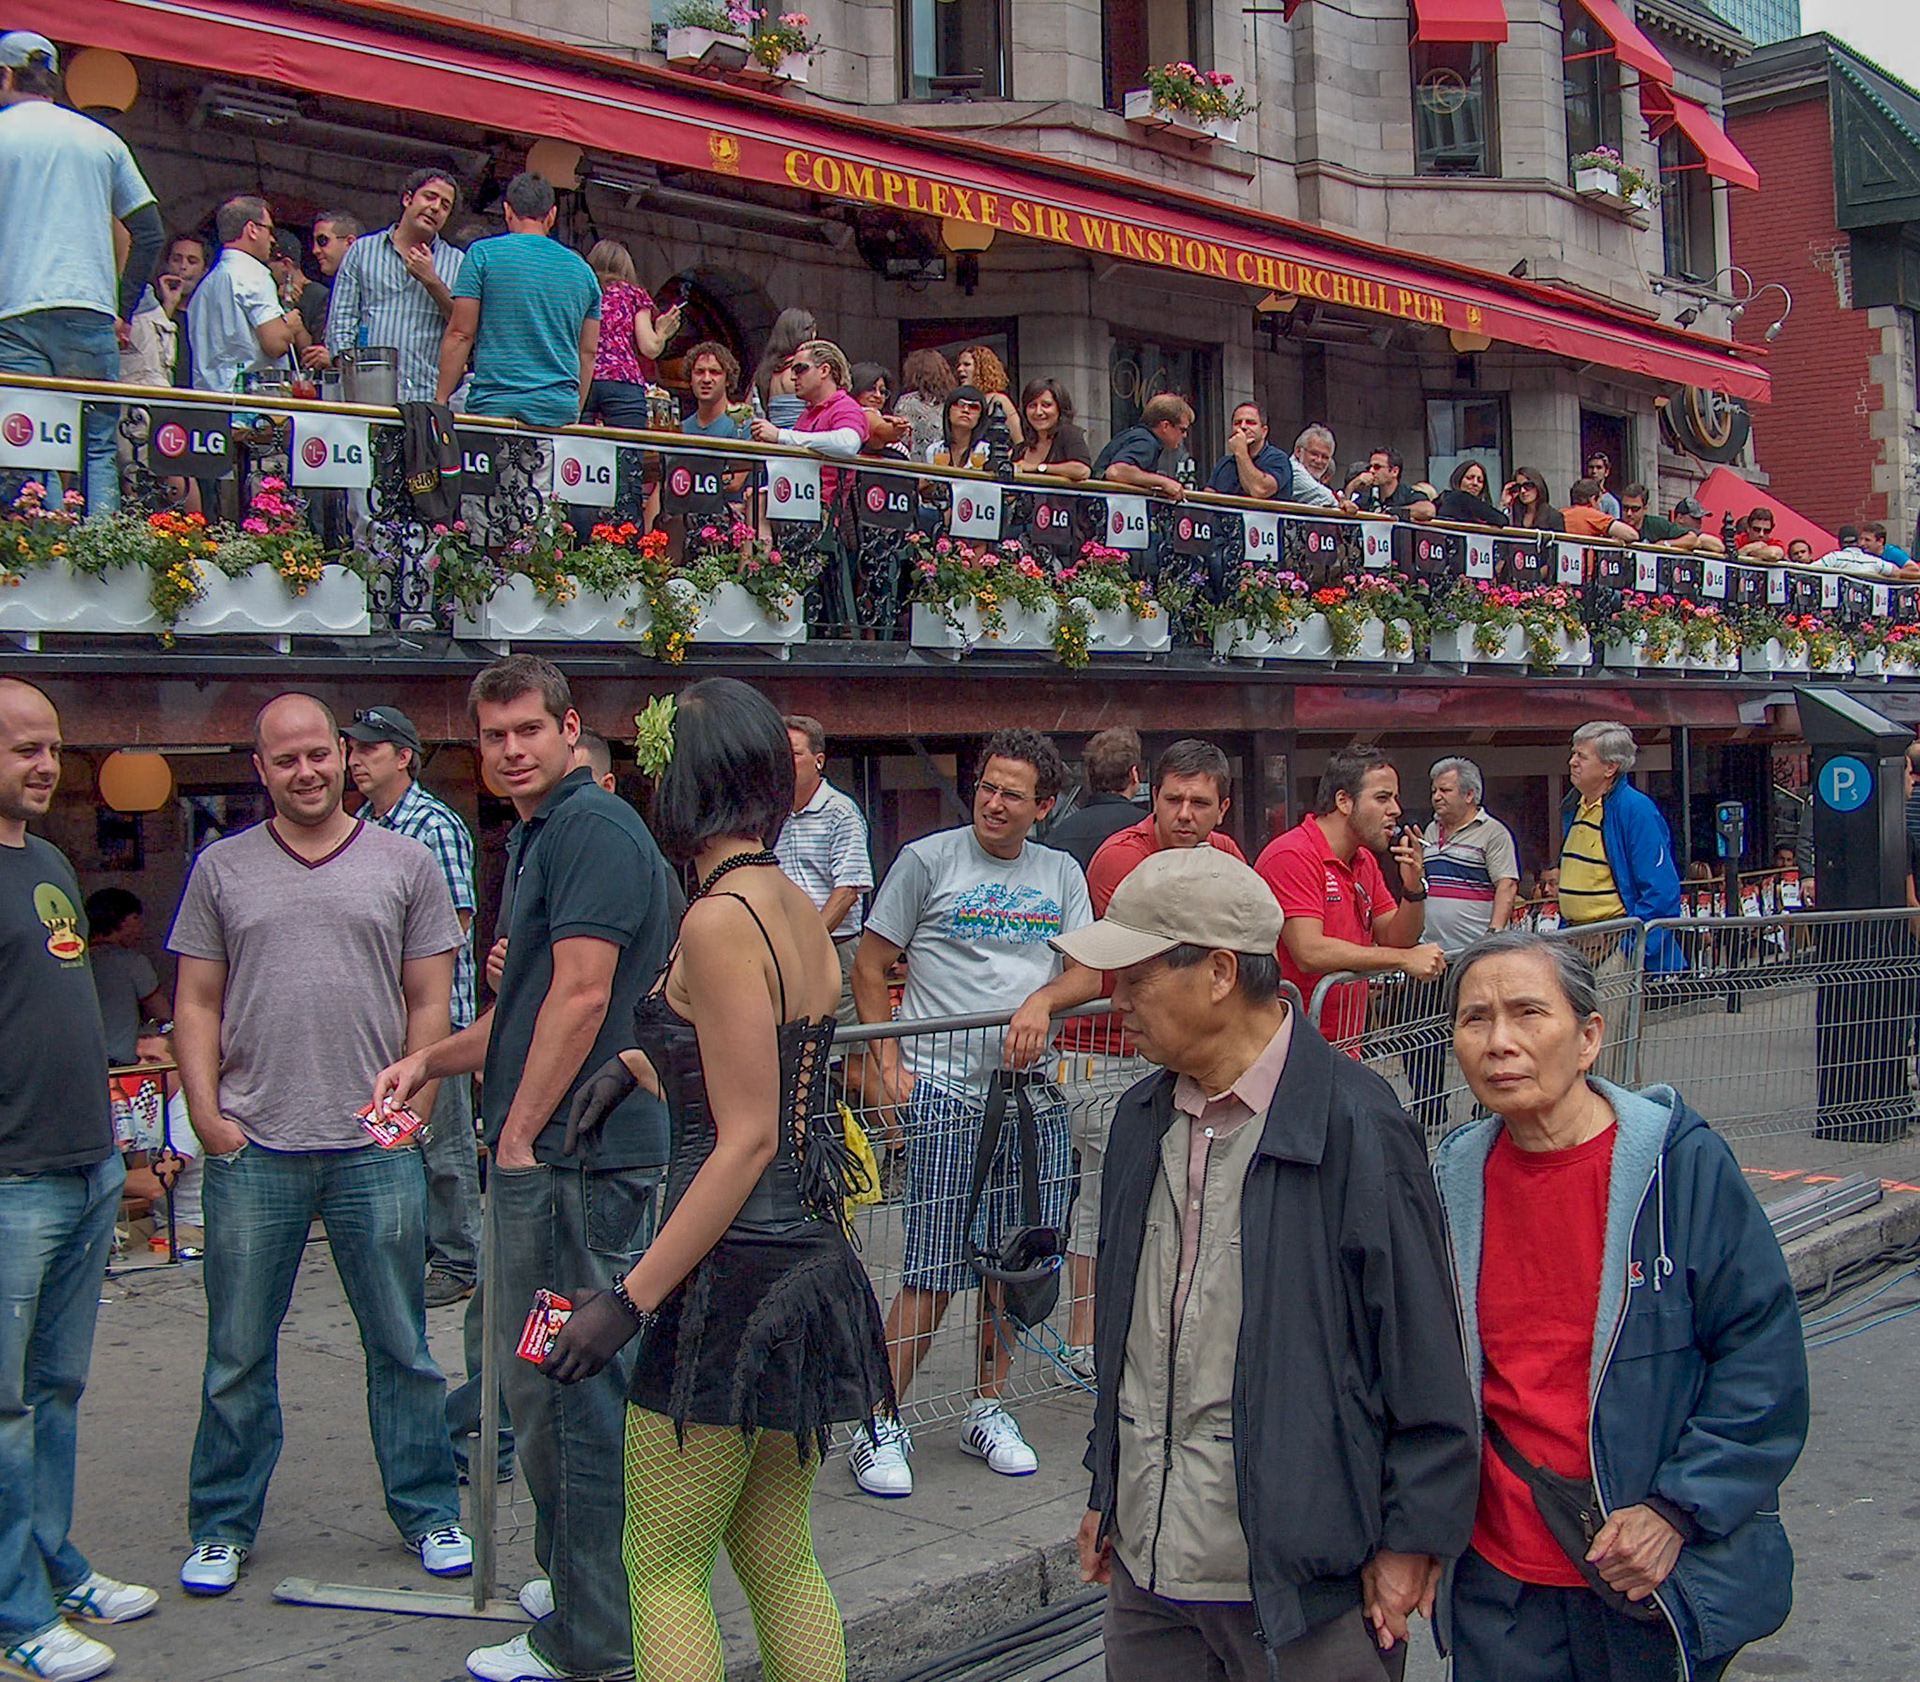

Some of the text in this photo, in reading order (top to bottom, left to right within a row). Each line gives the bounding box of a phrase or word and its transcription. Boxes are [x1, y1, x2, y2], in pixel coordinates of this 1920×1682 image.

[784, 149, 1444, 325] COMPLEXE SIR WINSTON CHURCHILL PUB
[40, 425, 72, 444] LG
[192, 431, 227, 455] LG
[333, 442, 362, 465] LG
[463, 451, 490, 474] LG
[586, 463, 610, 485] LG
[695, 474, 717, 493] LG
[795, 483, 814, 501] LG
[889, 493, 908, 512] LG
[976, 503, 995, 521] LG
[1052, 509, 1067, 526] LG
[1127, 515, 1144, 531] LG
[1194, 523, 1211, 539] LG
[1261, 530, 1274, 545] LG
[1321, 535, 1334, 551] LG
[1378, 539, 1389, 554] LG
[1430, 544, 1442, 559] LG
[1479, 548, 1490, 564] LG
[1525, 555, 1537, 568] LG
[1571, 559, 1579, 570] LG
[1608, 563, 1619, 574] LG
[1647, 568, 1655, 579] LG
[1681, 570, 1690, 581] LG
[1714, 574, 1723, 585] LG
[1746, 580, 1754, 592] LG
[1776, 581, 1783, 592] LG
[1802, 584, 1811, 595] LG
[1830, 585, 1836, 596] LG
